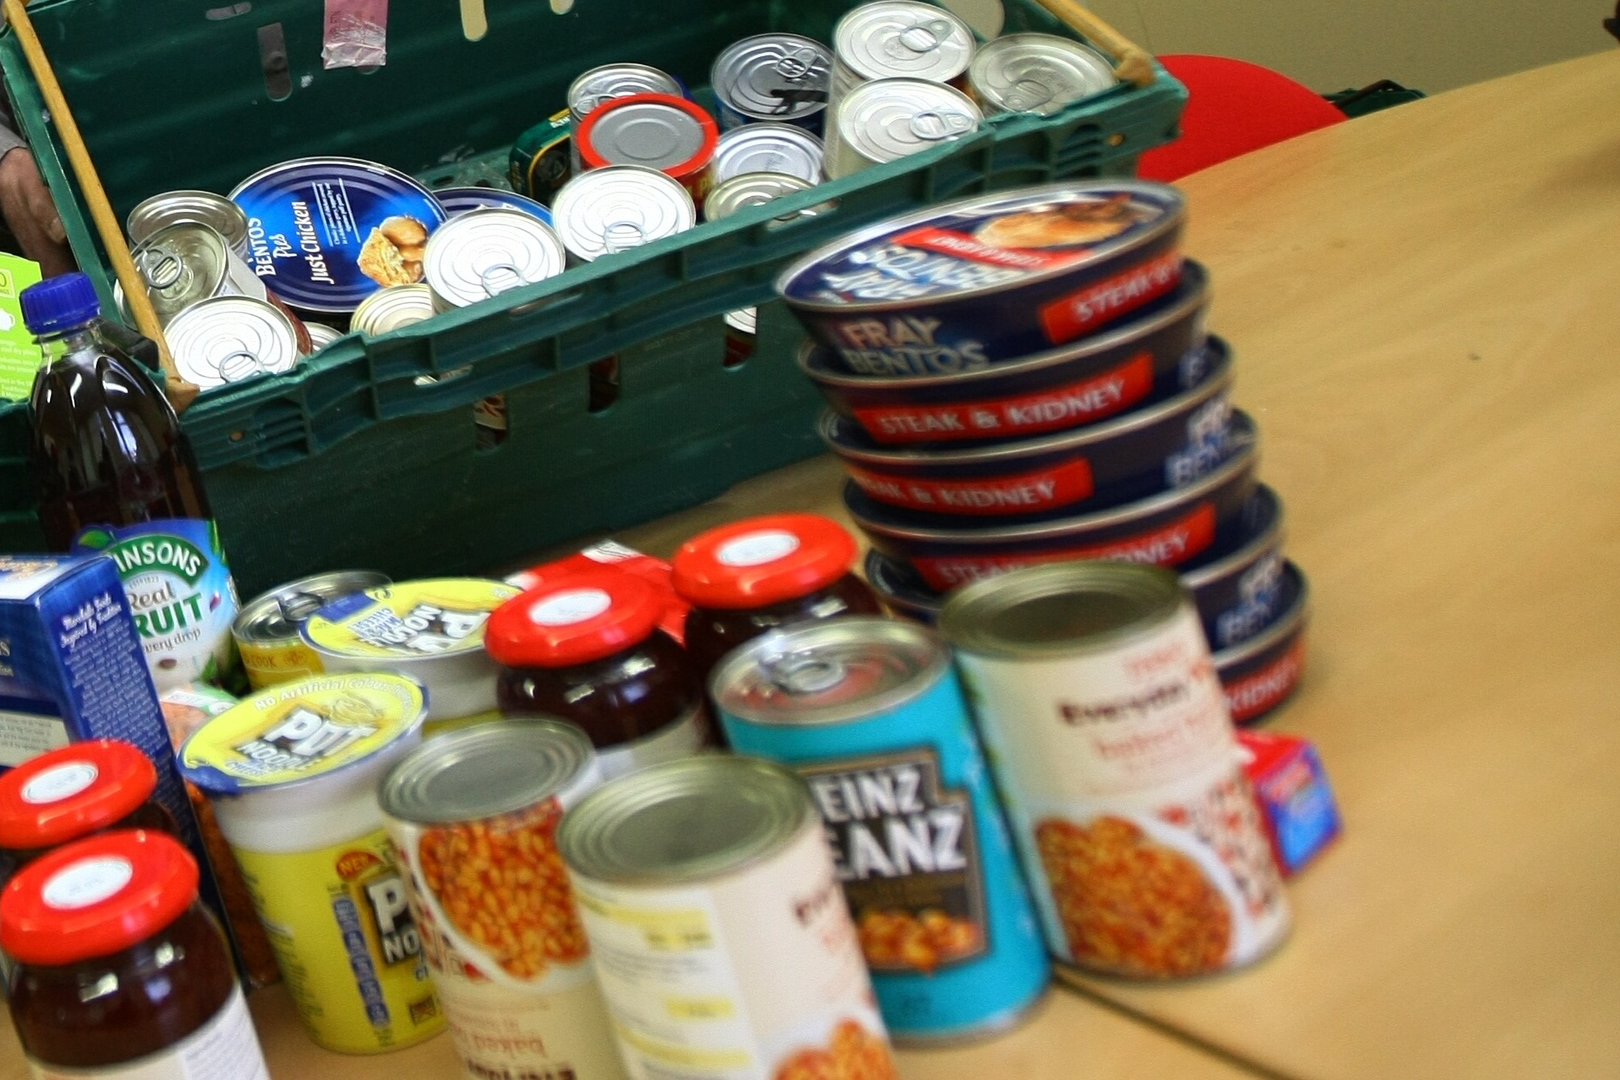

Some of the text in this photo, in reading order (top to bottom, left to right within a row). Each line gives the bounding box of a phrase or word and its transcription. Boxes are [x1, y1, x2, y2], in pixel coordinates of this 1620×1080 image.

[291, 202, 321, 253] Chicken
[247, 217, 277, 276] BENTOS
[268, 234, 297, 258] Pies
[305, 253, 335, 285] Just
[1073, 270, 1150, 324] STEAK
[842, 315, 942, 350] FRAY
[841, 340, 989, 376] BENTOS
[879, 377, 1126, 436] STEAK & KIDNEY
[910, 486, 935, 505] &
[940, 479, 1057, 508] KIDNEY
[126, 580, 177, 611] Real
[132, 592, 204, 639] RUIT
[144, 626, 202, 654] very drop
[255, 696, 277, 711] No
[280, 678, 347, 702] Artificial
[263, 709, 379, 758] POT
[810, 767, 927, 822] EINZ
